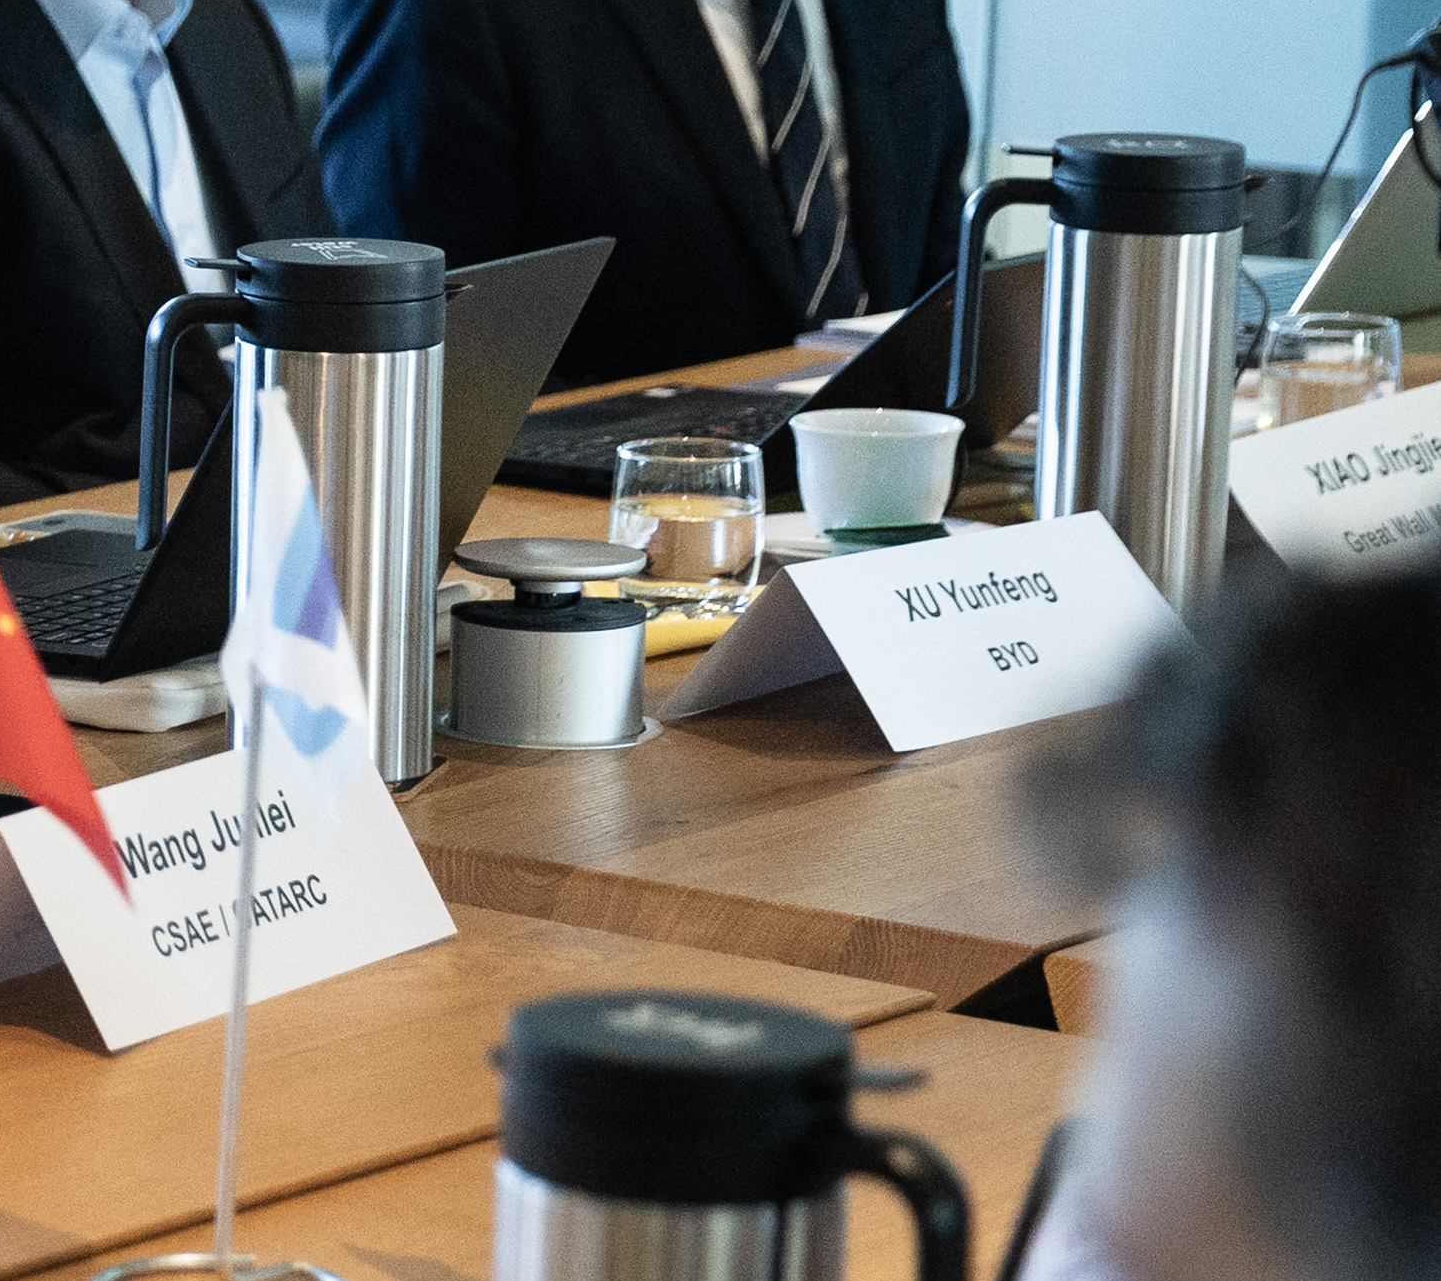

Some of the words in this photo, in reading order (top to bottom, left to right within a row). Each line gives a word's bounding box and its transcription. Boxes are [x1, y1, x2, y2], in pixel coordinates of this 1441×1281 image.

[1305, 453, 1371, 494] XIAO
[1343, 522, 1399, 553] Great
[895, 585, 942, 622] XU
[937, 572, 1058, 603] Yunfeng
[987, 641, 1039, 671] BYD
[113, 829, 207, 879] Wang
[210, 789, 296, 852] Julei
[151, 910, 220, 957] CSAE
